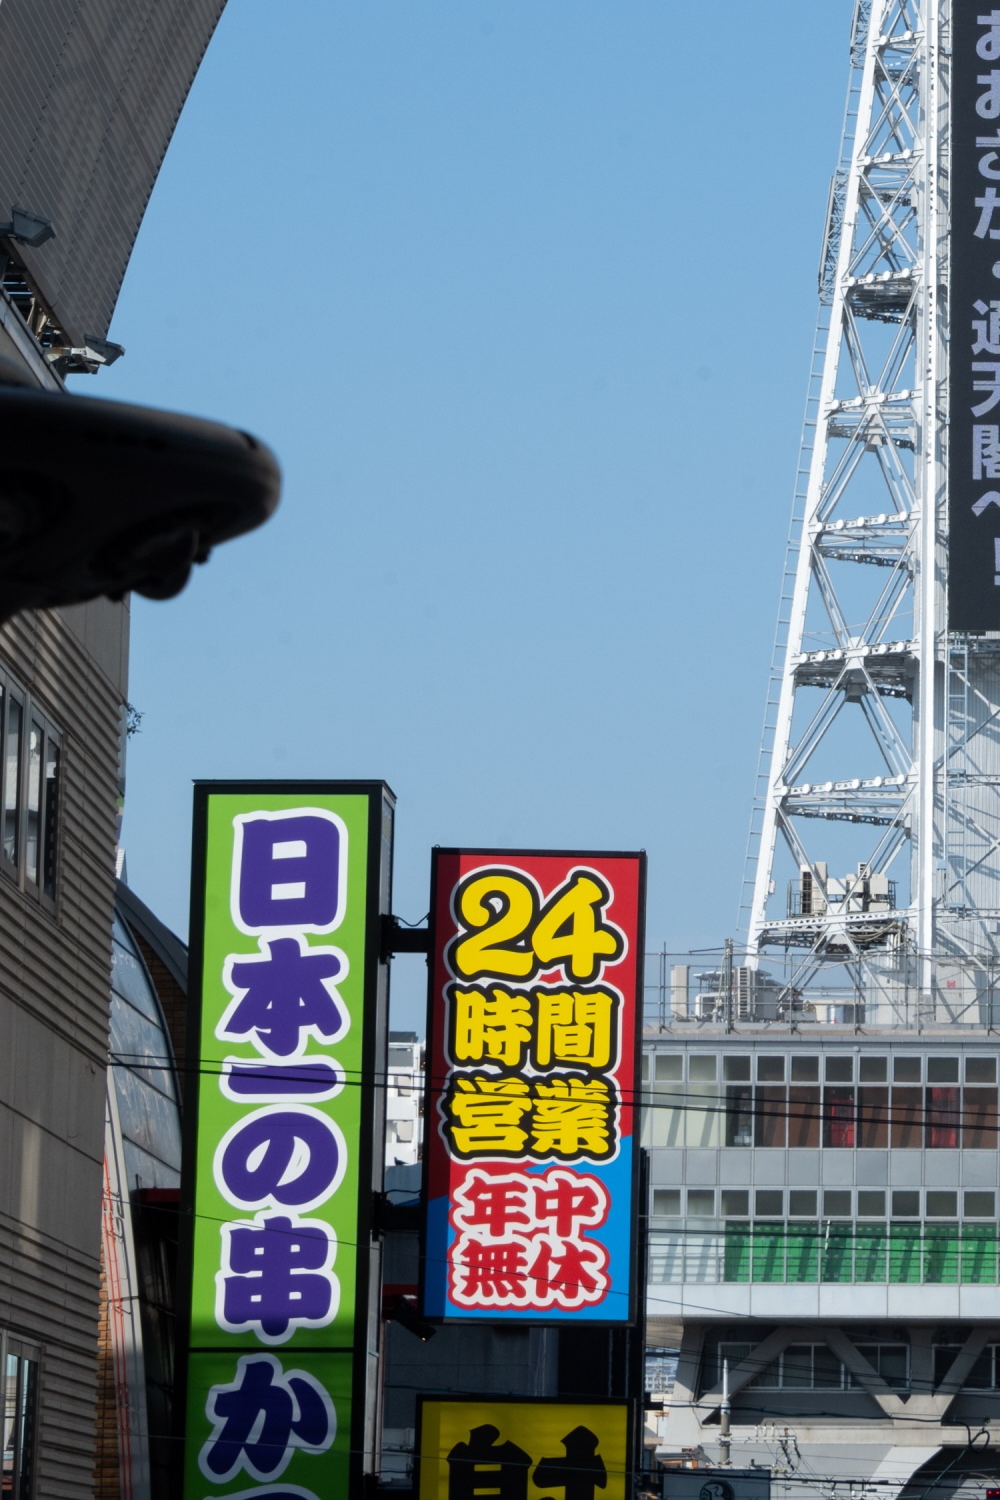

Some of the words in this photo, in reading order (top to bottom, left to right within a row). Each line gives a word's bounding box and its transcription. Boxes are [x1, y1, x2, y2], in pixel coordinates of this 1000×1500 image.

[456, 875, 617, 978] 24
[455, 989, 613, 1067] 時間
[450, 1076, 611, 1154] 営業
[206, 816, 342, 1500] 日本一の串か
[461, 1176, 599, 1237] 年中
[460, 1238, 599, 1299] 無休
